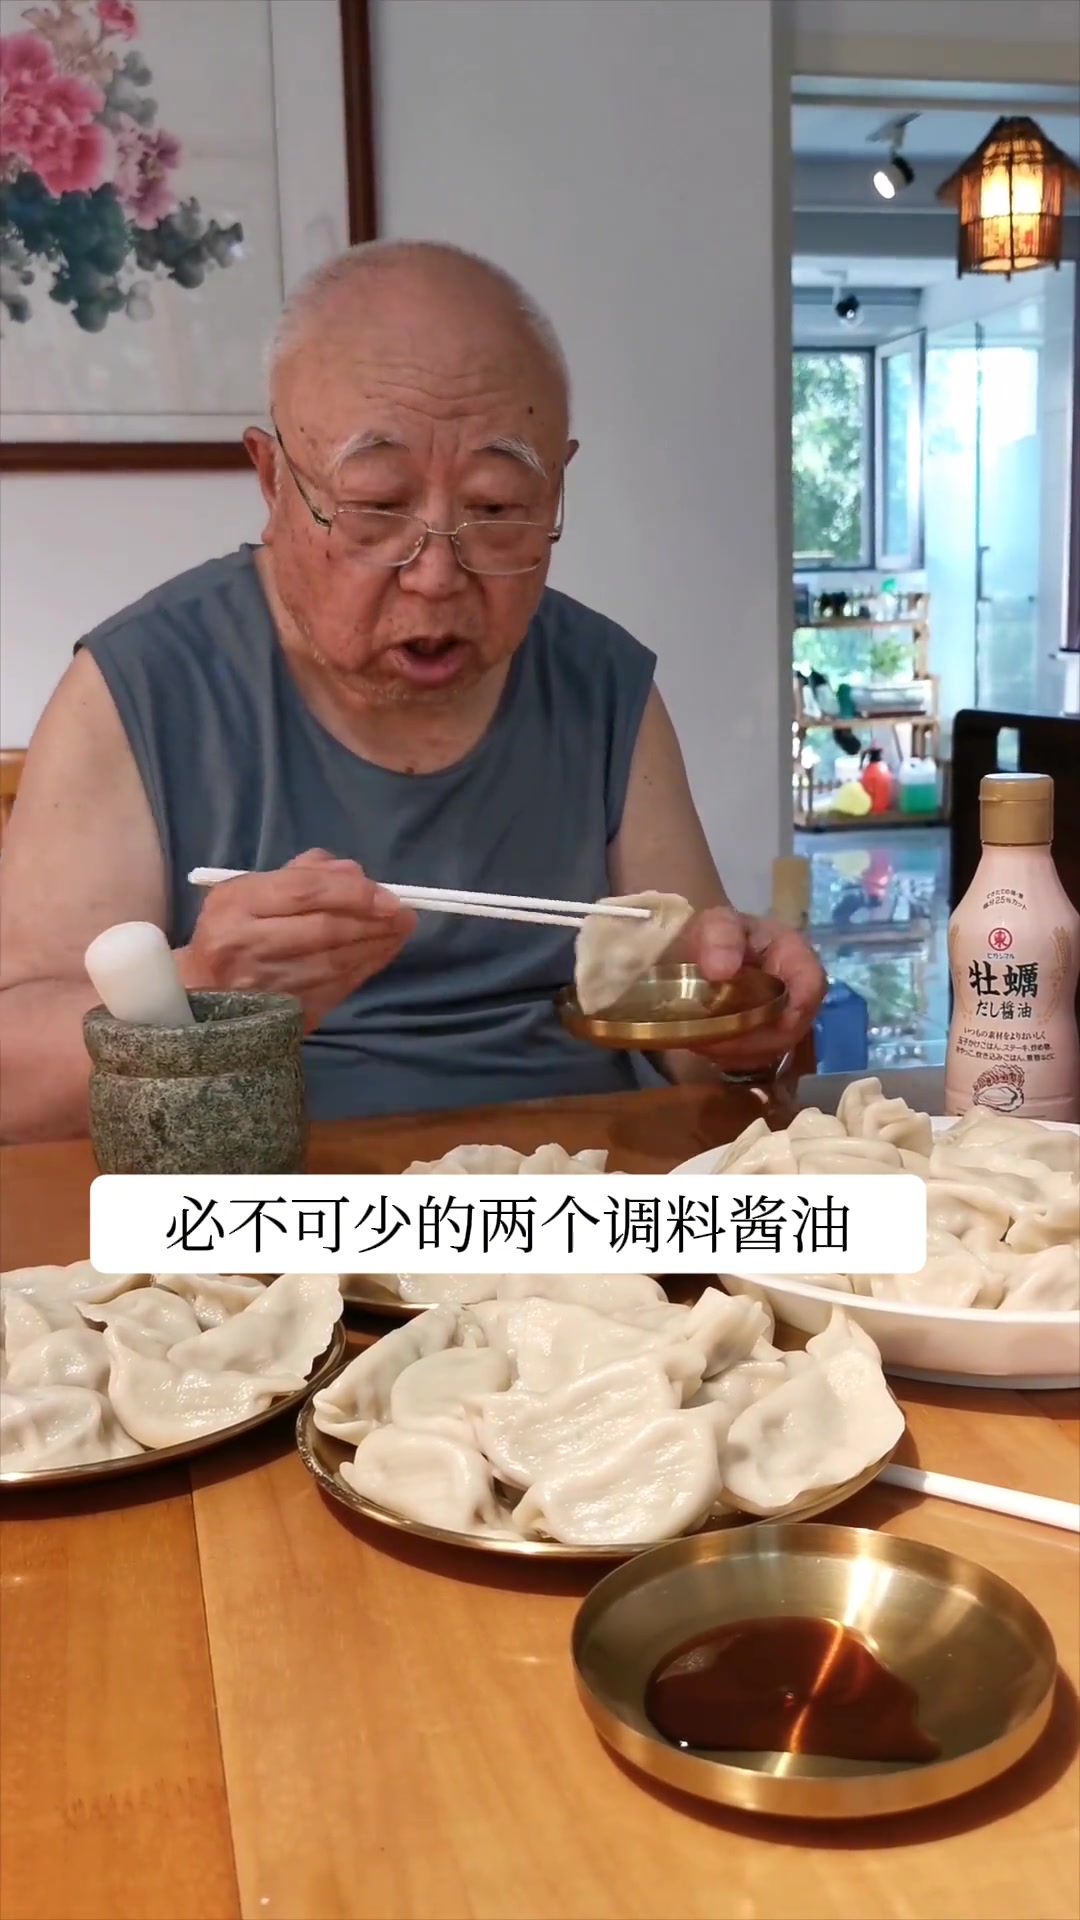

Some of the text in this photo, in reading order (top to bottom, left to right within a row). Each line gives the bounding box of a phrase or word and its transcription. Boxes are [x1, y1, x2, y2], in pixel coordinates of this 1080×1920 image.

[992, 929, 1009, 950] 東
[968, 960, 1039, 998] 牡蠣
[976, 1000, 1032, 1020] だし醤油
